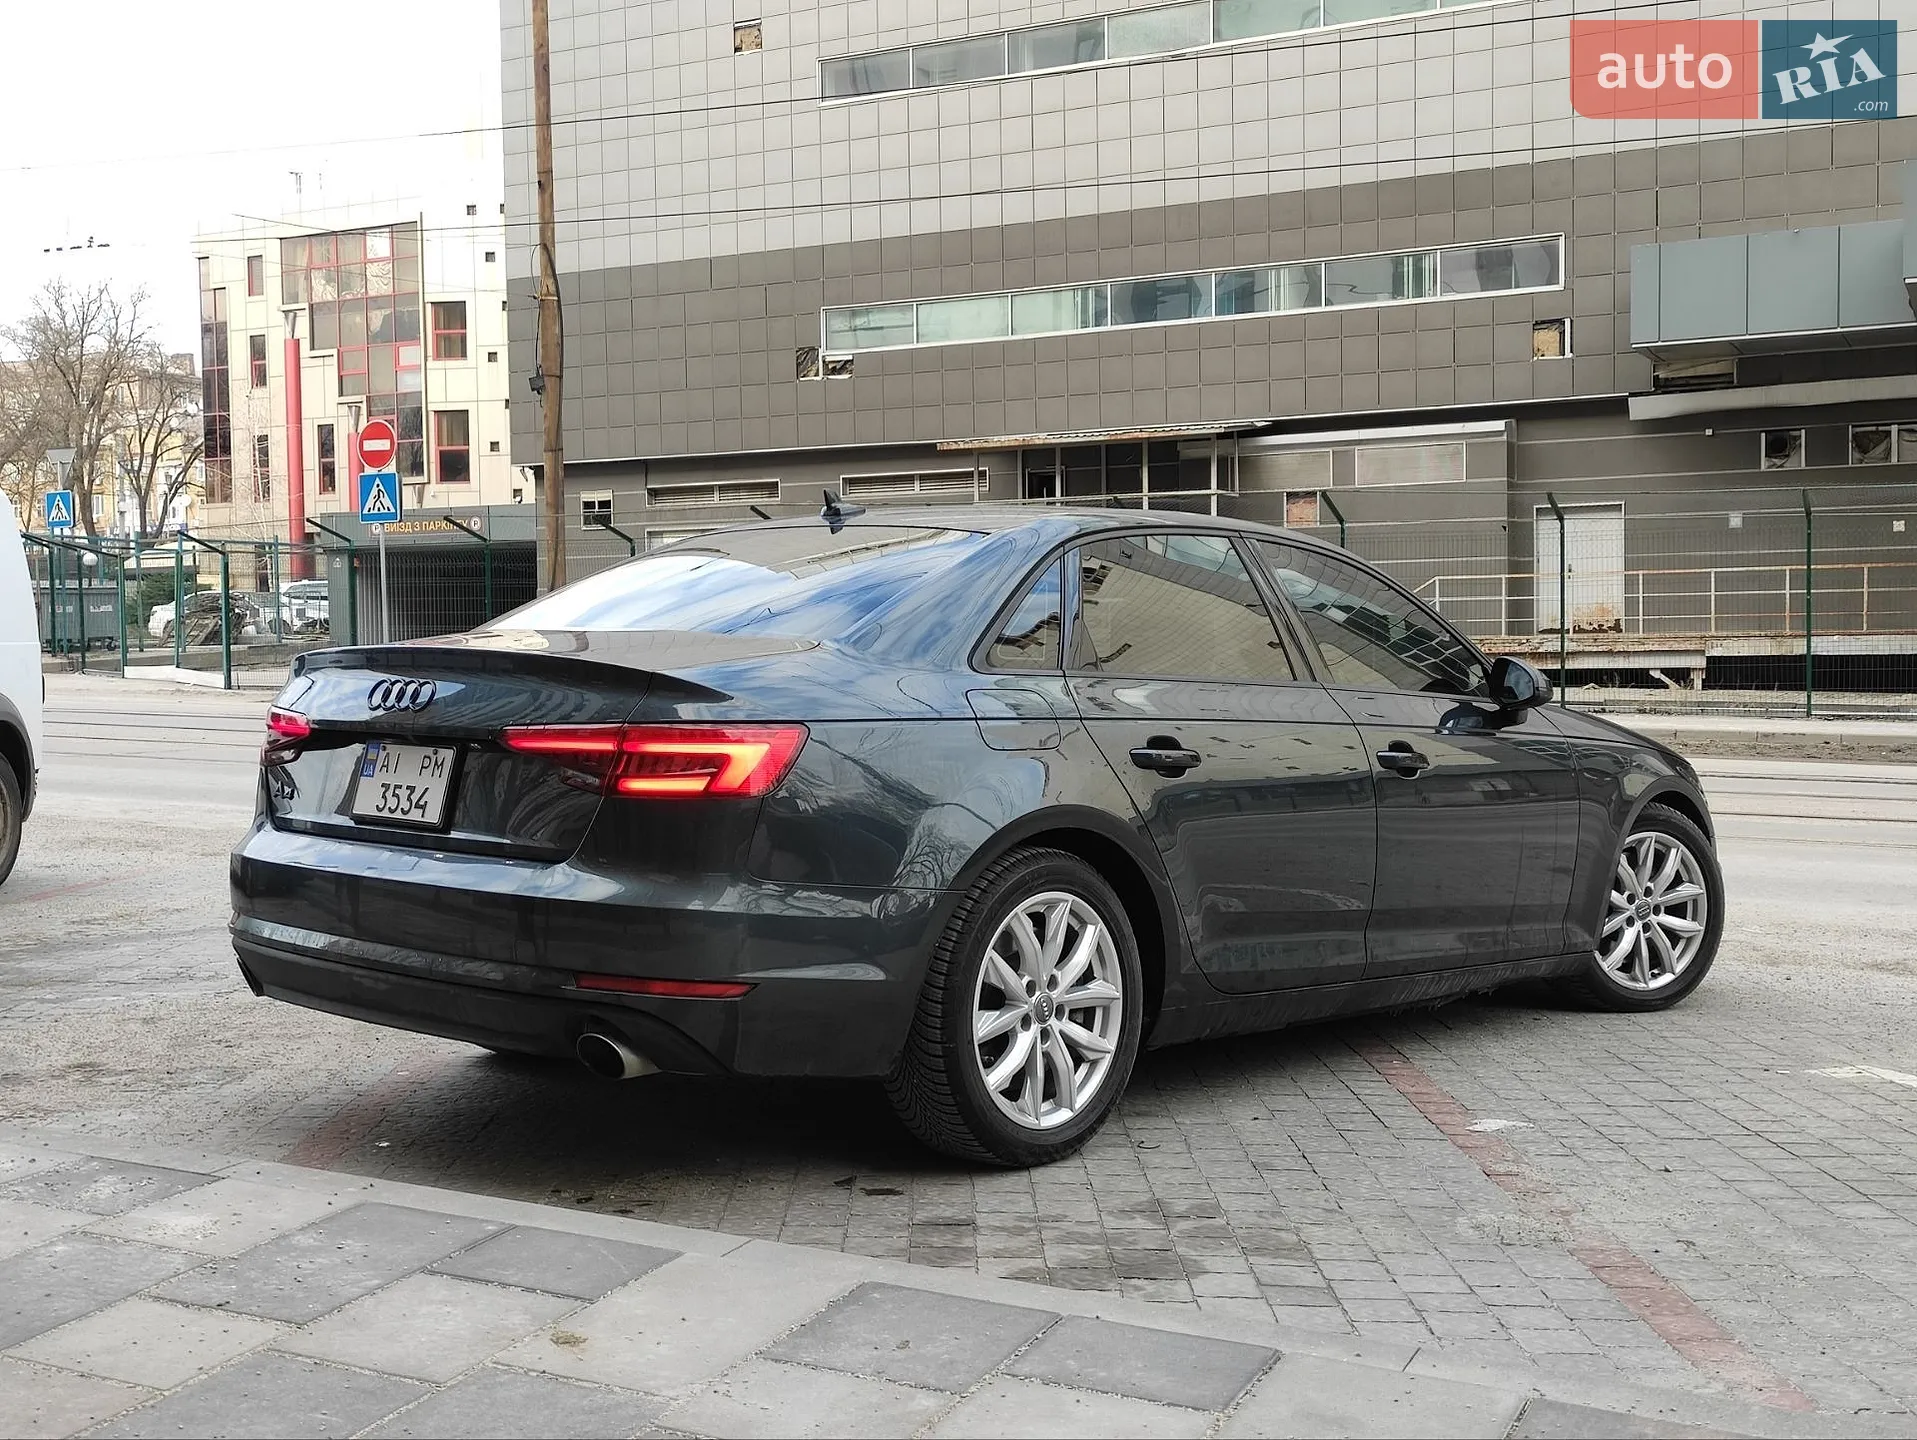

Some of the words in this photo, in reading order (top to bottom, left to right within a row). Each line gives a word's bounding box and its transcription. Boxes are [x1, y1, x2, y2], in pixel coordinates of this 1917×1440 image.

[363, 763, 374, 776] UA
[379, 752, 401, 774] AI
[418, 754, 446, 778] PM
[375, 782, 430, 818] 3534
